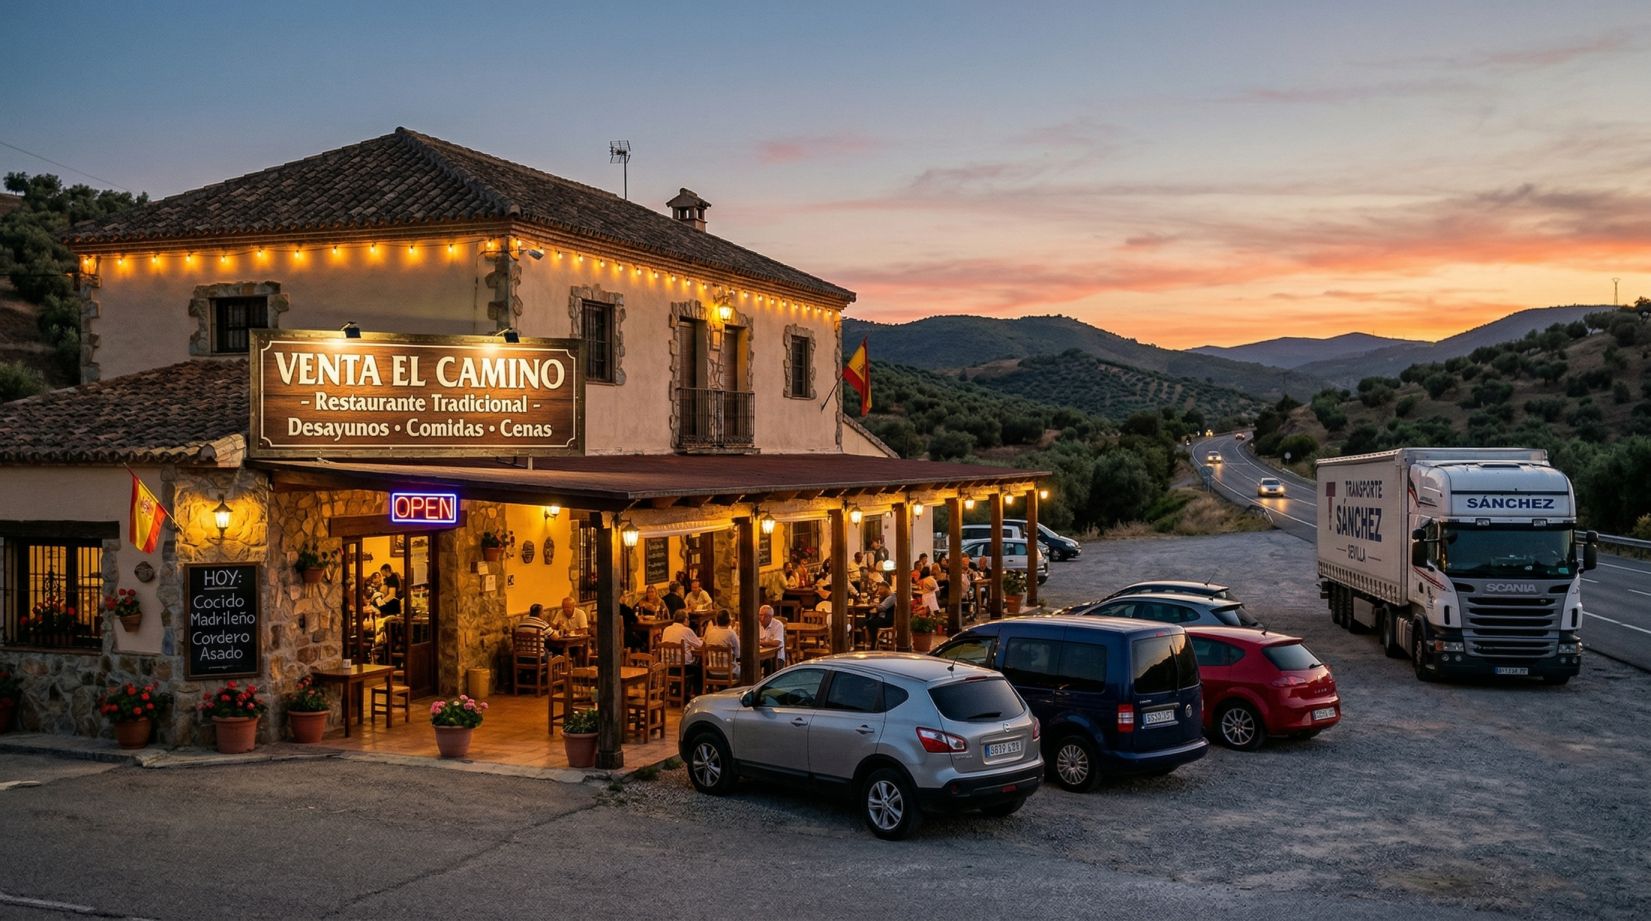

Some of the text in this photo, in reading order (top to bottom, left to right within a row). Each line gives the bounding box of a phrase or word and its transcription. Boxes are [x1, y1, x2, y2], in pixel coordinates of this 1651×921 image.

[274, 352, 565, 389] VENTA EL CAMINO
[314, 391, 527, 413] Restaurante Tradicional
[287, 417, 552, 442] Desayunos Comidas Cenas
[1345, 480, 1382, 499] TRANSPORTE
[395, 496, 453, 520] OPEN
[1466, 495, 1555, 510] SÁNCHEZ
[1336, 498, 1382, 542] SÁNCHEZ
[204, 569, 242, 586] HOY:
[1486, 583, 1537, 593] SCANIA
[193, 592, 245, 609] Cocido
[190, 610, 256, 627] Madrileño
[192, 629, 250, 646] Cordero
[199, 645, 244, 662] Asado
